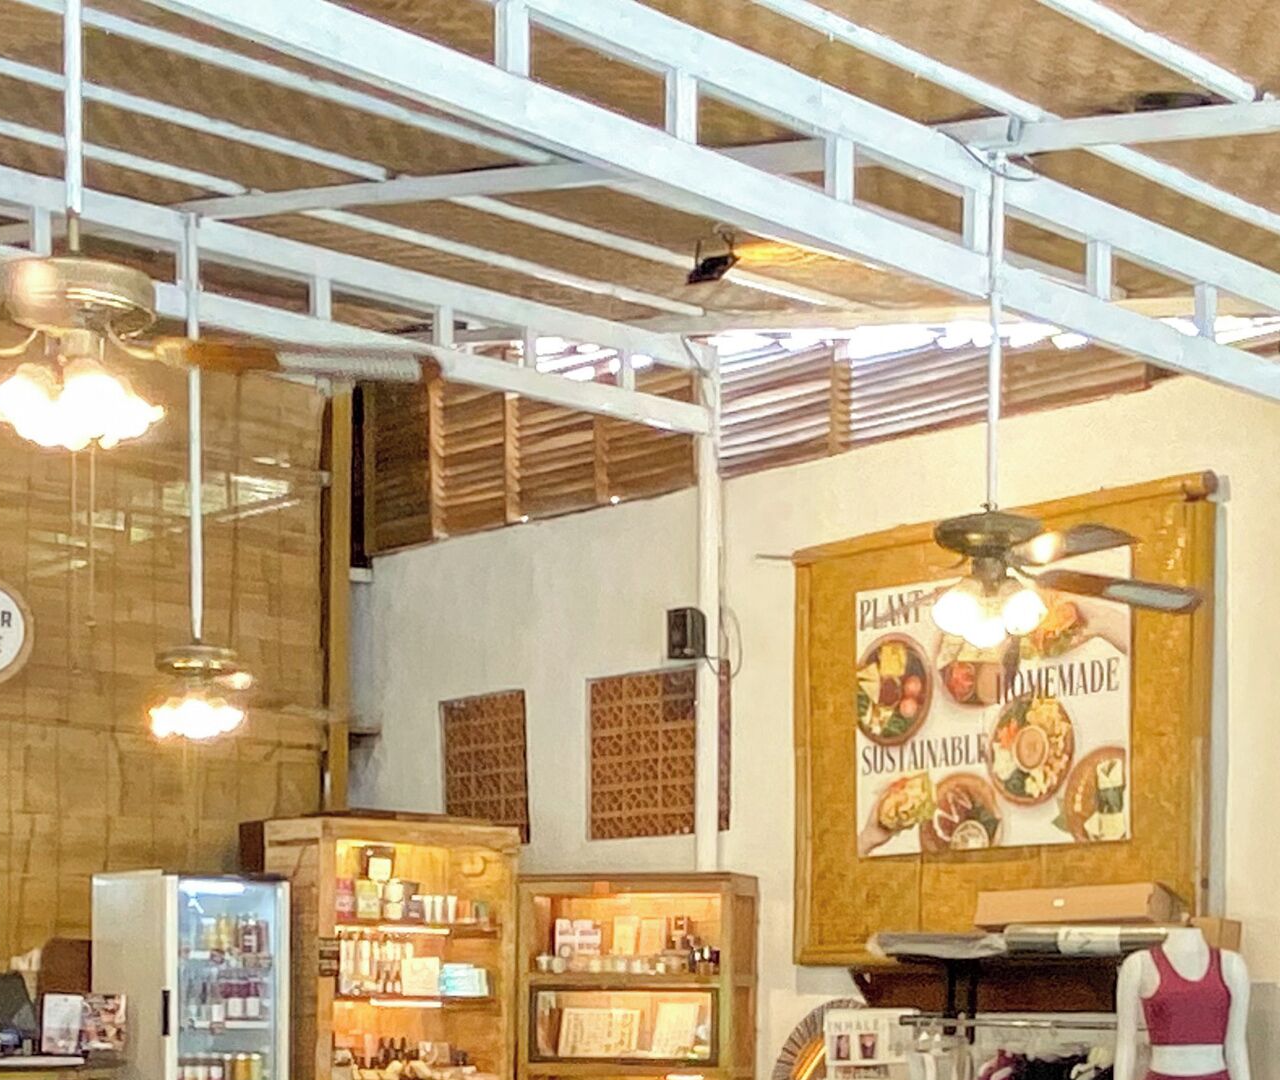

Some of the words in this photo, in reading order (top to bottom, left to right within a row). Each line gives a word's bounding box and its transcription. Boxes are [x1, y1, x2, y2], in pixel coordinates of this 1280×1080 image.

[859, 589, 923, 631] PLANT
[995, 656, 1121, 705] HOMEMADE
[861, 732, 988, 776] SUSTAINABLE
